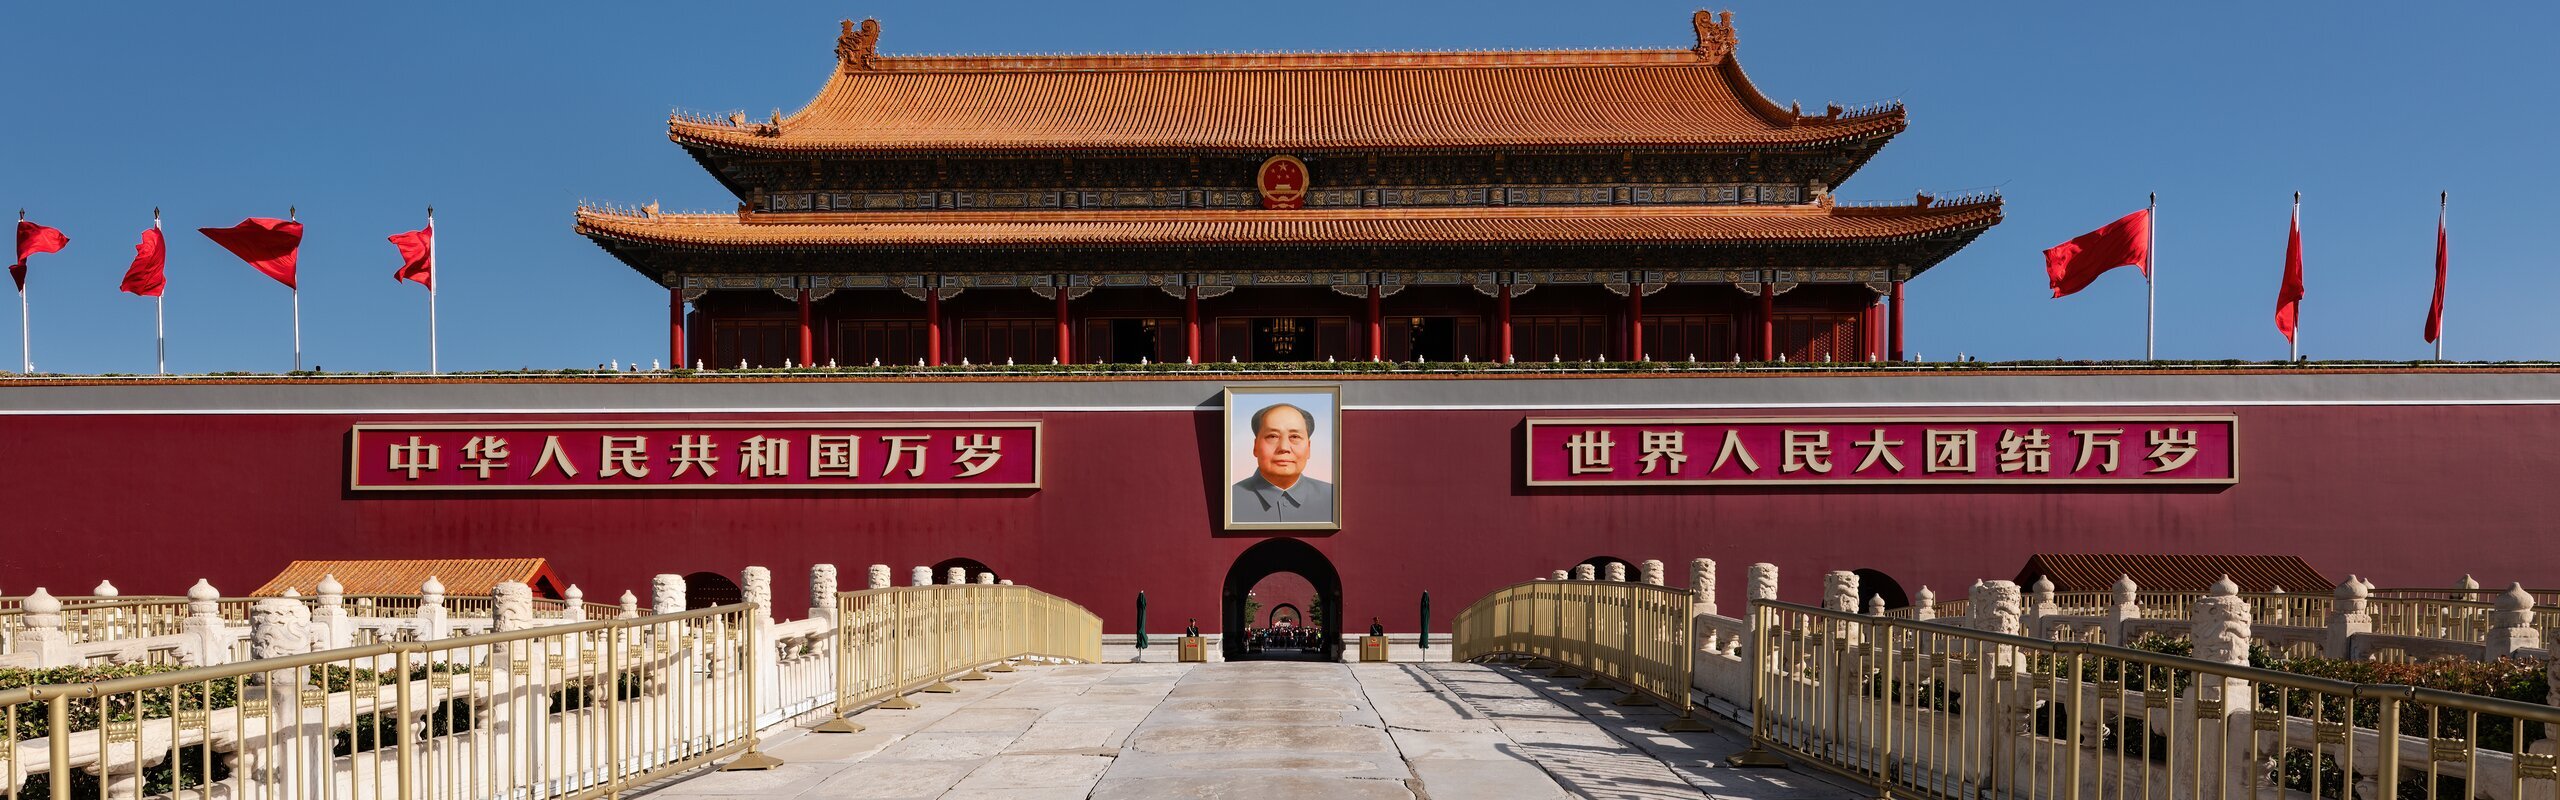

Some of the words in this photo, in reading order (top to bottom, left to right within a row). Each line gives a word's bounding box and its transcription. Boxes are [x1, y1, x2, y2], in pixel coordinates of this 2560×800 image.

[388, 433, 1003, 480] 中华人民共和国万岁
[1566, 427, 2199, 474] 世界人民大团结万岁
